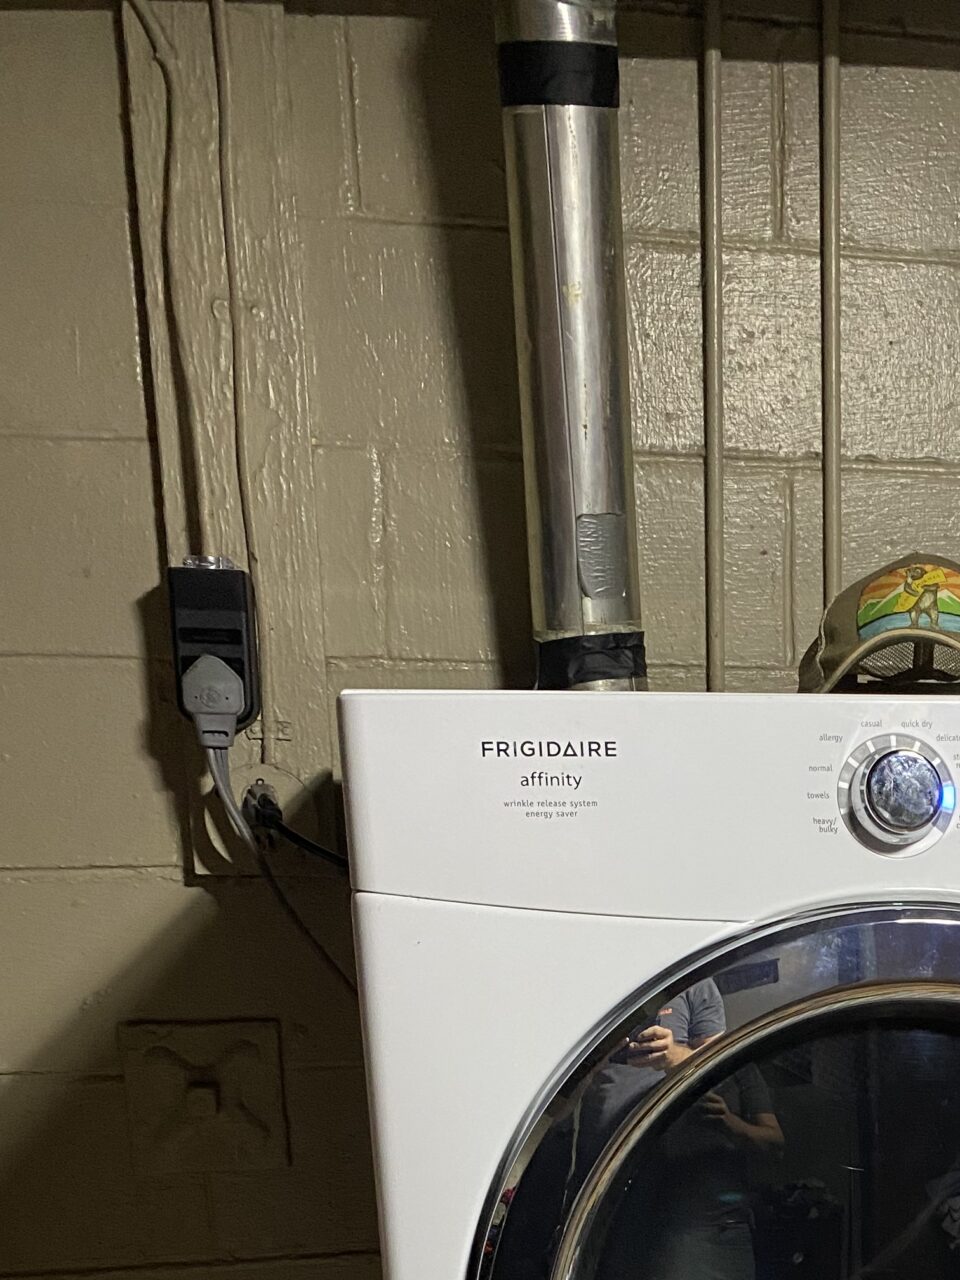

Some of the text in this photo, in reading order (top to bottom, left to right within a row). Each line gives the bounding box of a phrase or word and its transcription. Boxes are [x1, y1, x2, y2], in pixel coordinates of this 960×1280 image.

[901, 720, 933, 729] quick dry
[819, 734, 843, 743] allergy
[481, 741, 617, 757] FRIGIDAIRE
[808, 764, 832, 772] normal
[520, 771, 582, 790] affinity
[569, 801, 598, 809] system
[525, 810, 553, 819] energy
[813, 817, 837, 826] heavy/
[819, 825, 838, 834] bulky
